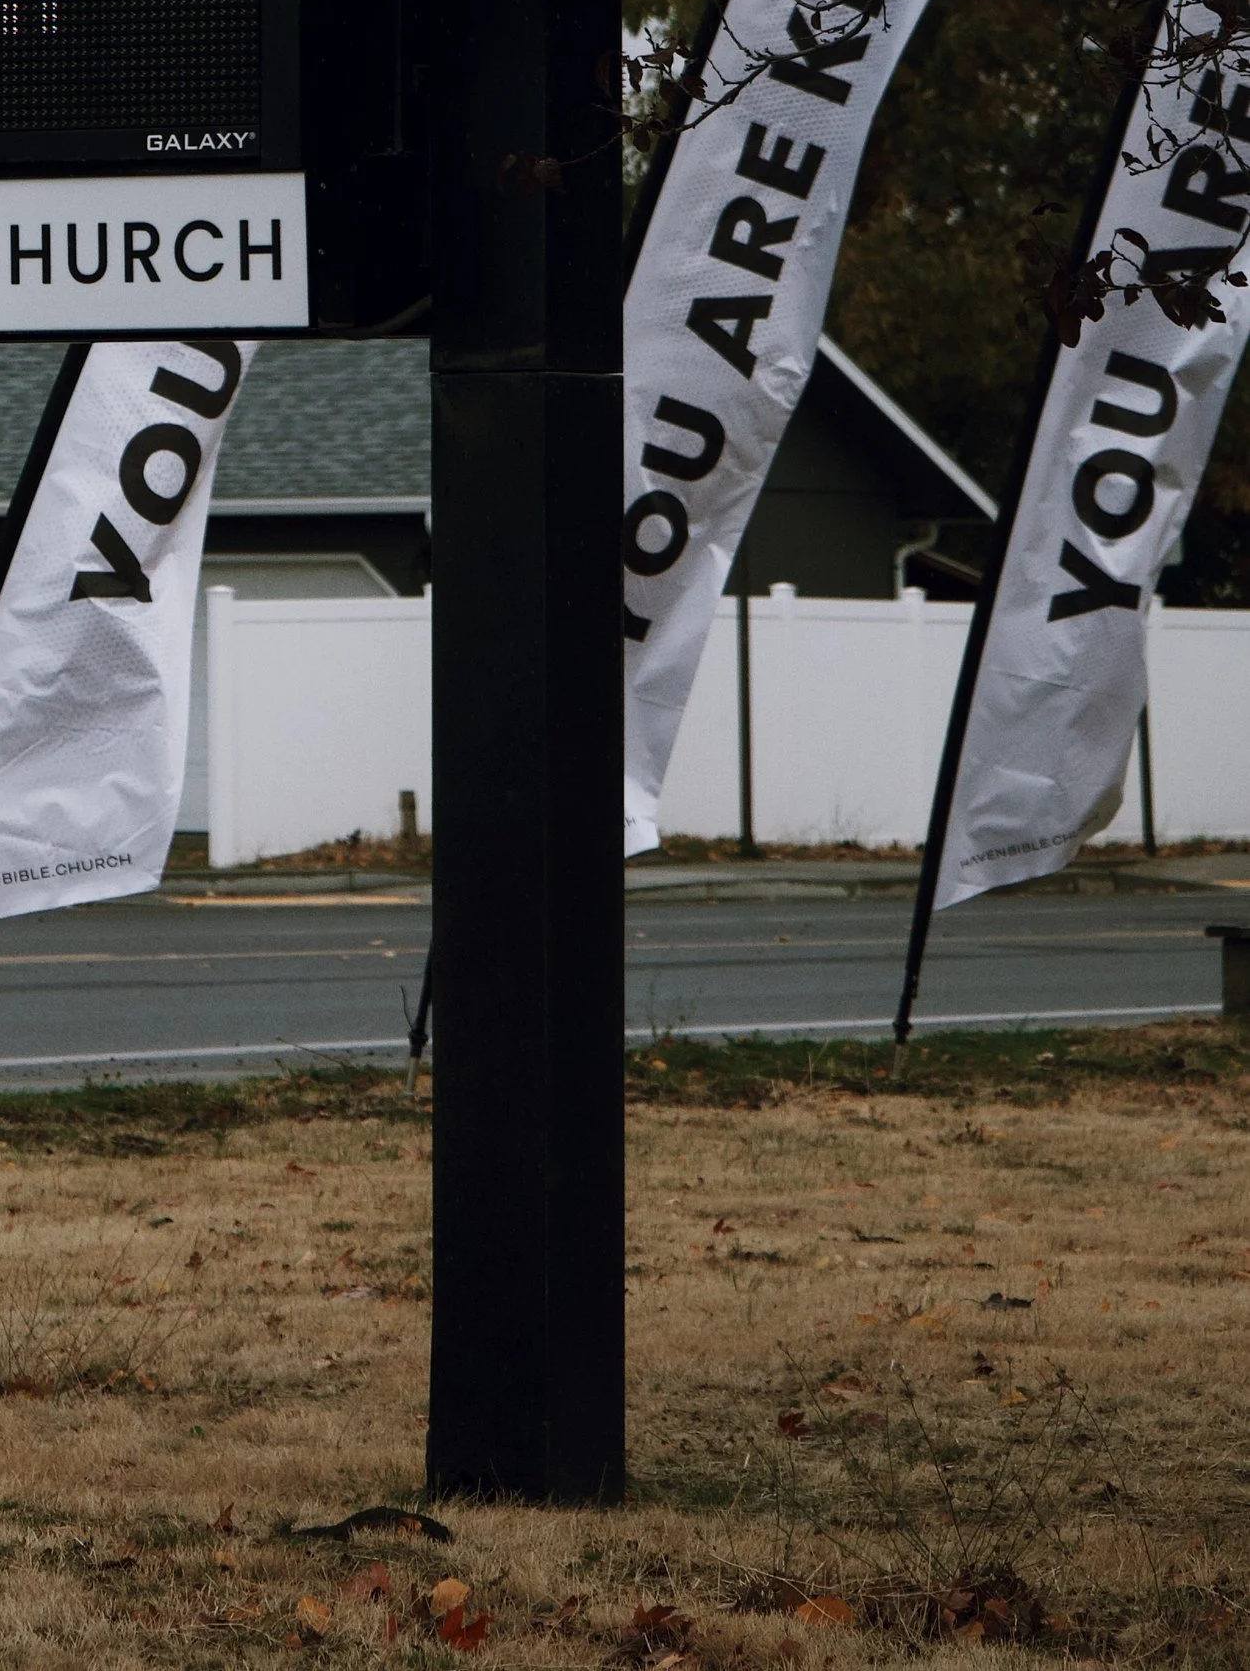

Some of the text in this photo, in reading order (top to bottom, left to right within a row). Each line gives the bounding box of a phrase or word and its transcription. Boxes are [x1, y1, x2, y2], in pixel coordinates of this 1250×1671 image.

[685, 121, 826, 380] ARE
[69, 341, 242, 603] YOU
[1047, 350, 1178, 623] YOU
